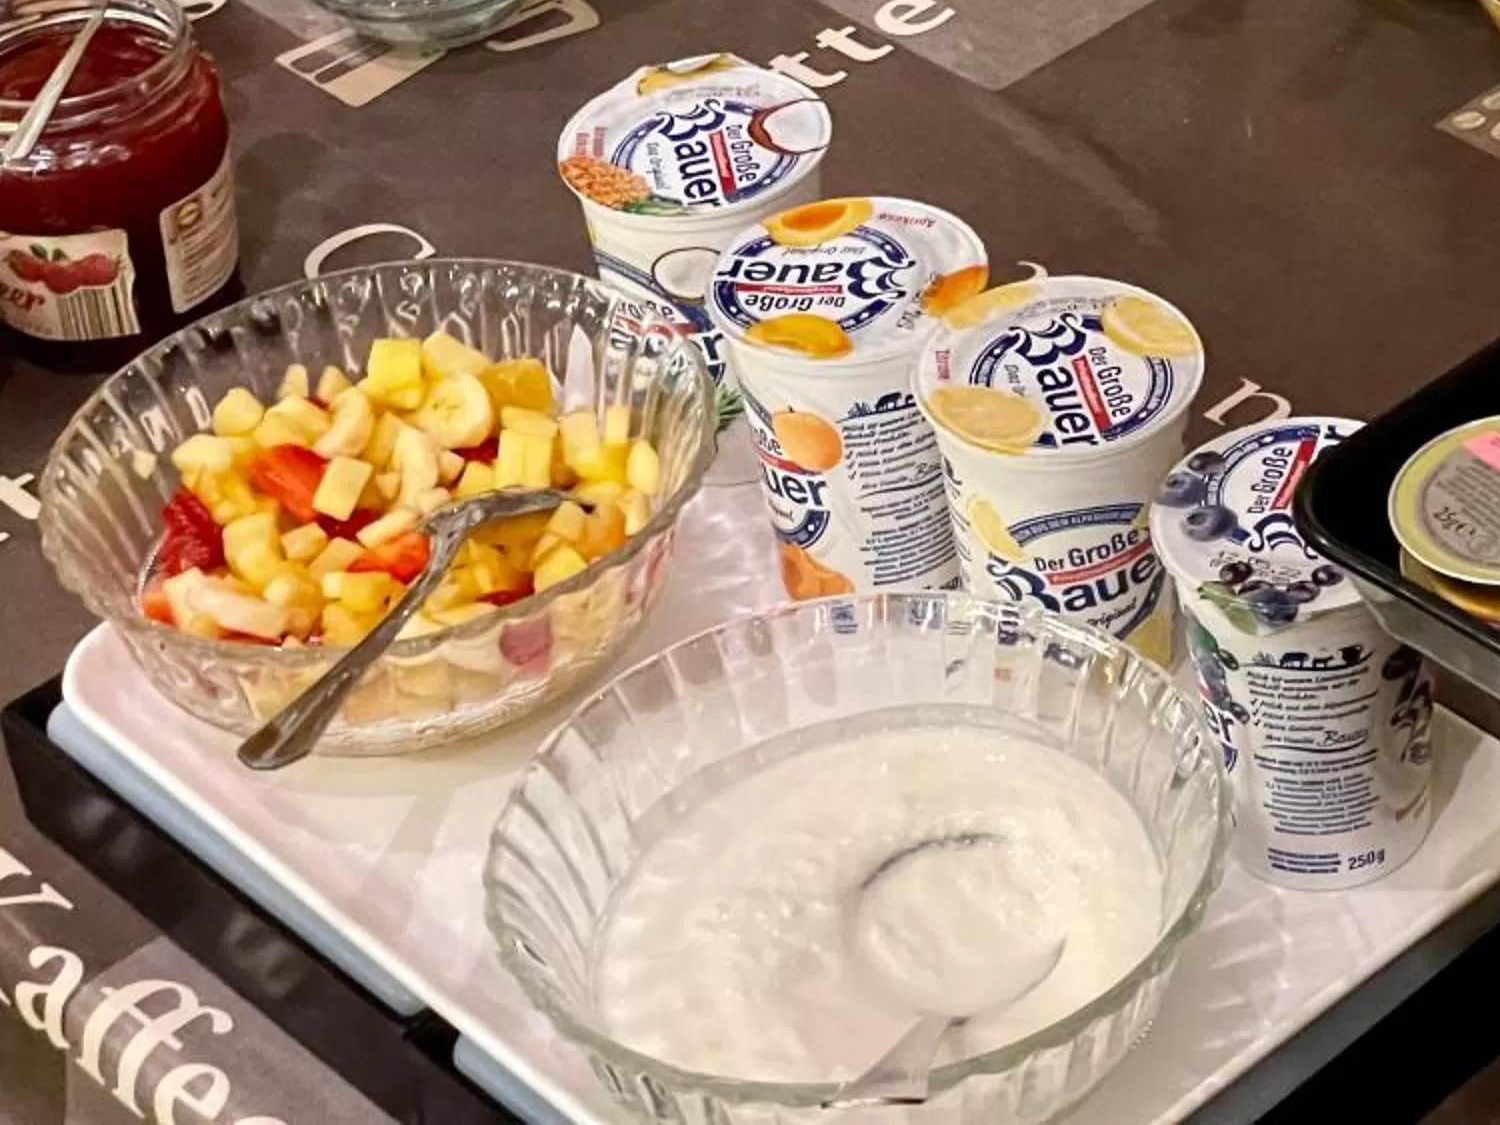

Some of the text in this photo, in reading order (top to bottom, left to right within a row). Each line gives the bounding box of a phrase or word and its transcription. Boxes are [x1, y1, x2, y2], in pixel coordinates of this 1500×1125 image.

[655, 98, 726, 212] Bauer
[734, 139, 761, 182] Große
[716, 256, 917, 300] Bauer
[745, 294, 847, 312] Der Große
[1009, 312, 1099, 447] Bauer
[1088, 346, 1134, 419] Der Große
[762, 462, 827, 506] uer
[1251, 446, 1293, 495] Große
[1247, 494, 1270, 514] Der
[1034, 527, 1140, 572] Der Große
[987, 552, 1157, 616] Baue
[1347, 849, 1386, 871] 250g
